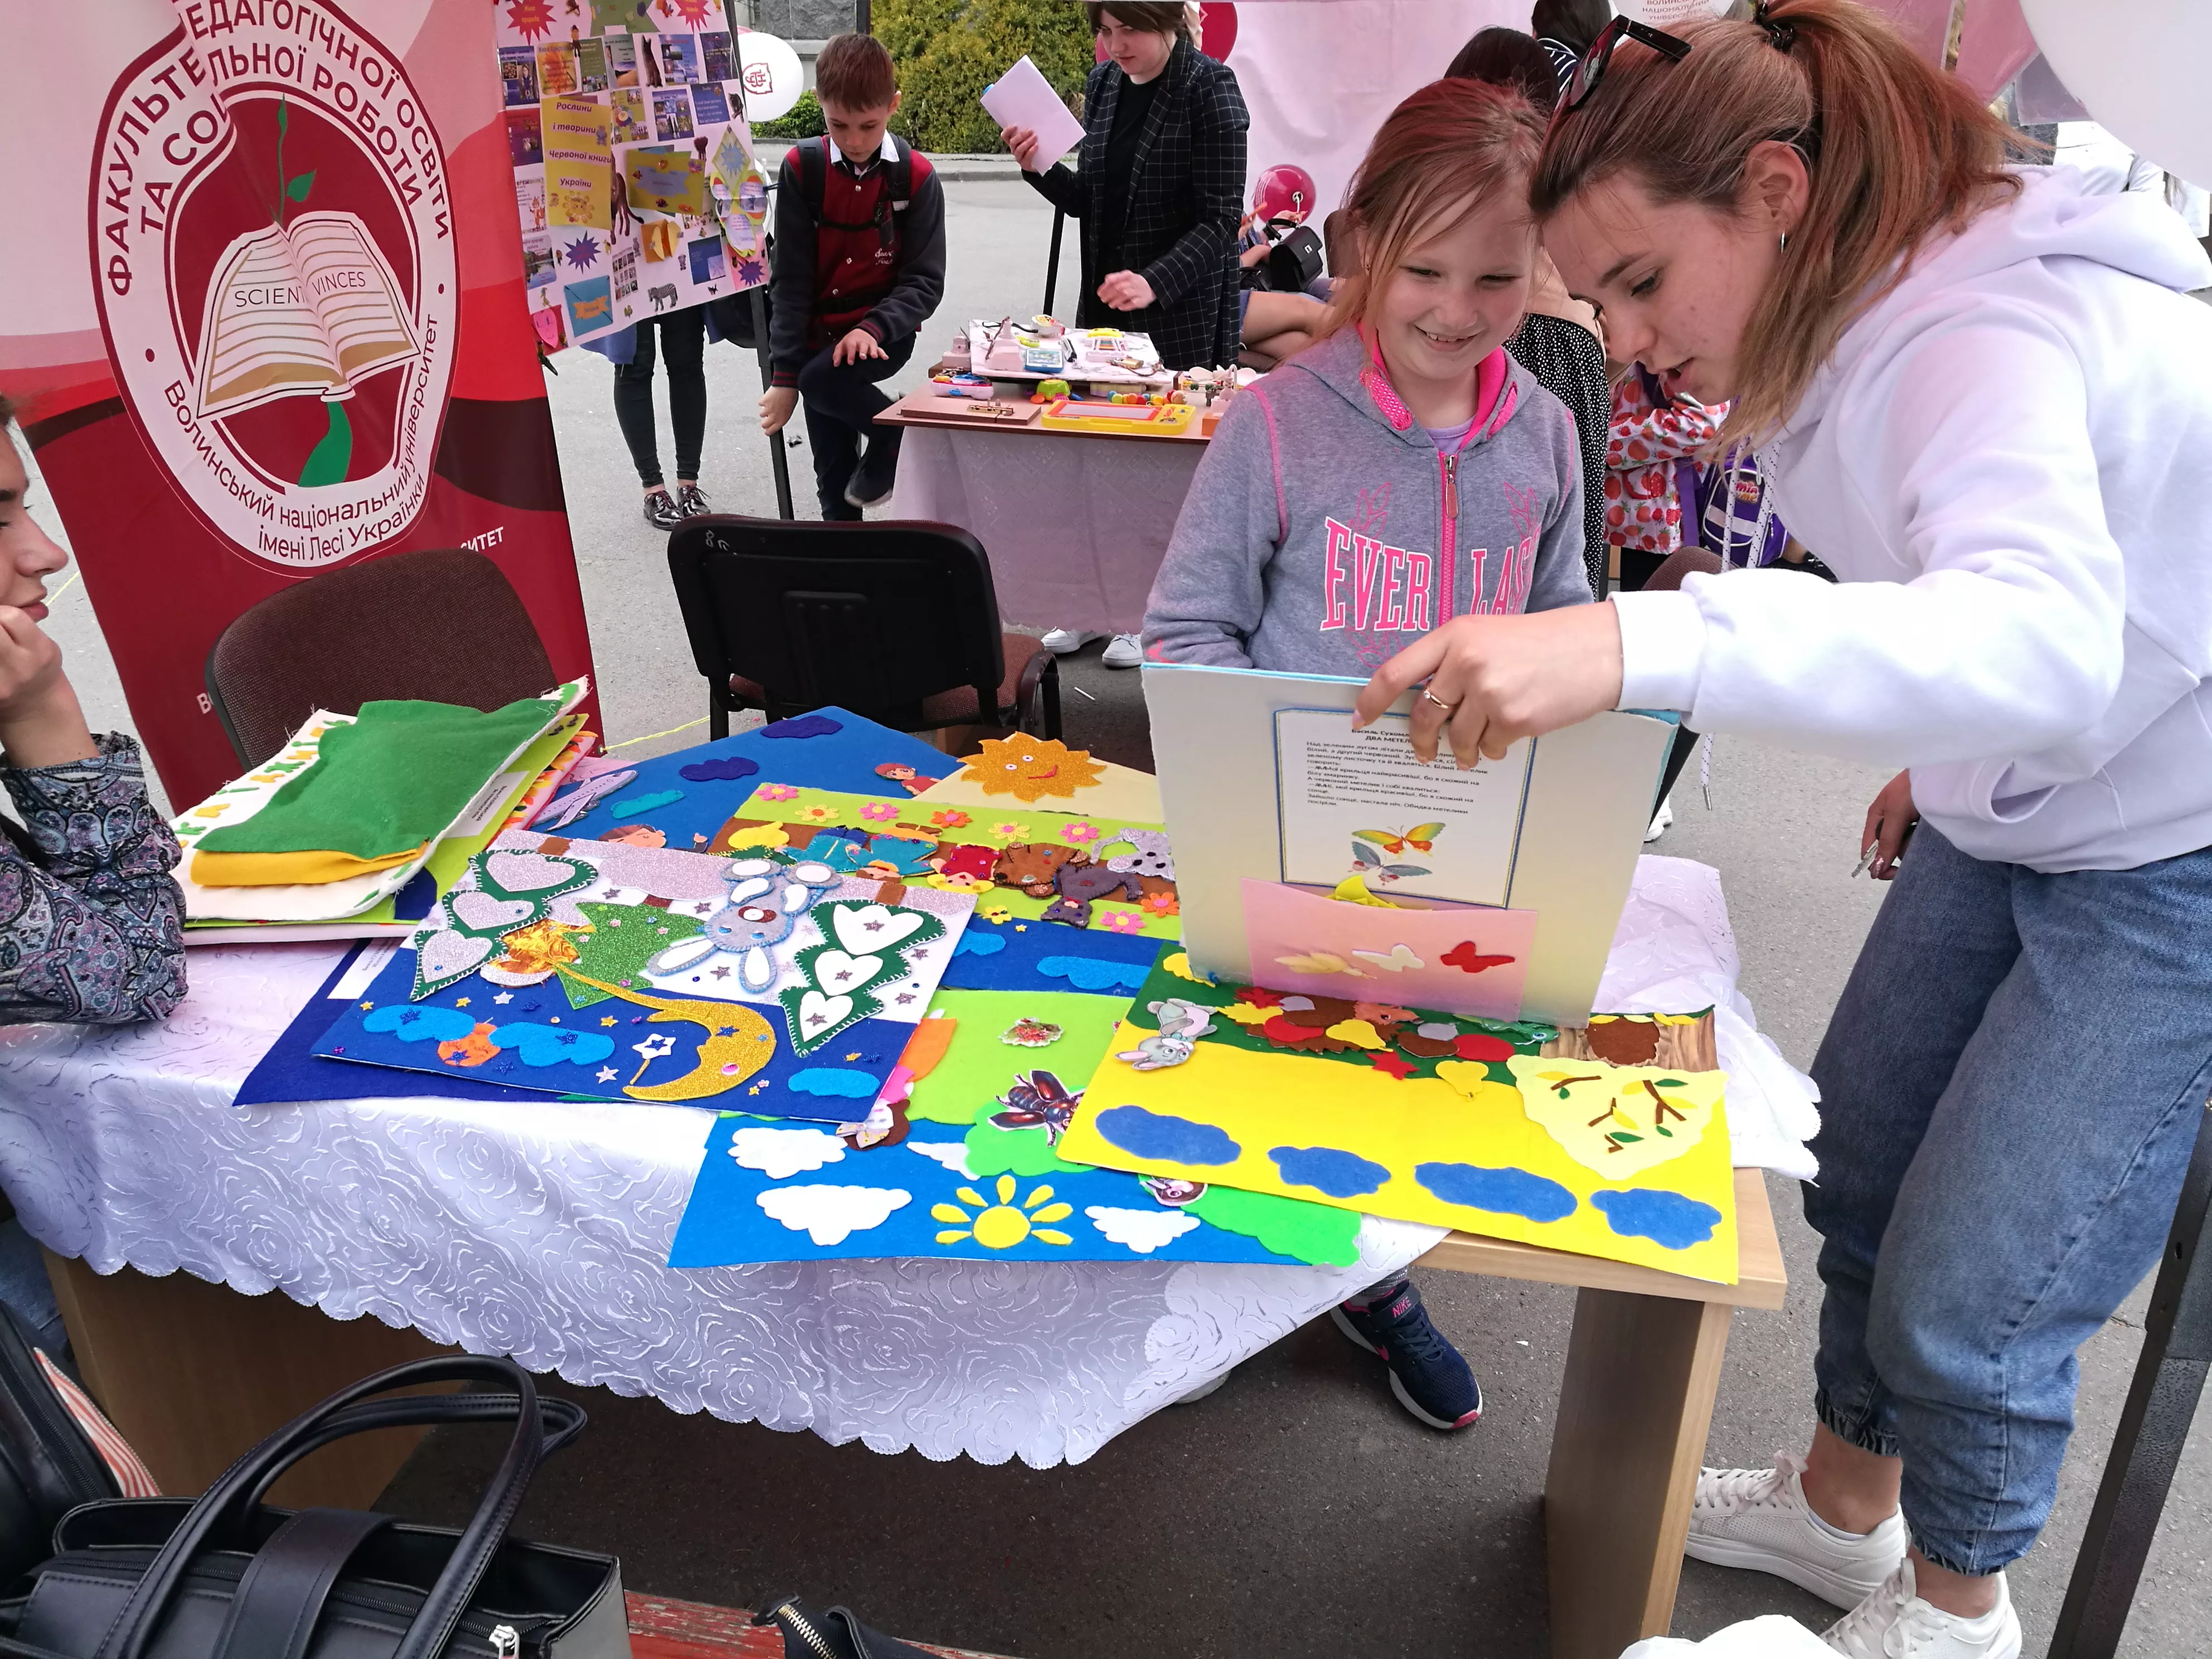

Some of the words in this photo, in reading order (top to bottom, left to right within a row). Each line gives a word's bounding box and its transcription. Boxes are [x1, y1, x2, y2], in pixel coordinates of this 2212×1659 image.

[557, 102, 592, 112] Рослини
[557, 125, 596, 134] тварини
[106, 47, 207, 297] ФАКУЛЬТЕ
[178, 0, 400, 99] ЕДАГОГІЧНОЇ
[397, 99, 449, 240] ОСВІТИ
[140, 181, 174, 234] ТА
[312, 62, 424, 207] РОБОТИ
[549, 150, 587, 159] Червоної
[589, 155, 612, 163] книги
[560, 178, 592, 188] України
[312, 271, 366, 296] VINCES
[164, 379, 275, 522] Волинський
[280, 462, 411, 532] національний
[405, 314, 439, 473] університет
[258, 525, 305, 560] імені
[309, 530, 344, 562] Лесі
[348, 473, 425, 547] Українки
[1320, 516, 1433, 632] EVER
[1393, 1296, 1412, 1318] NIKE
